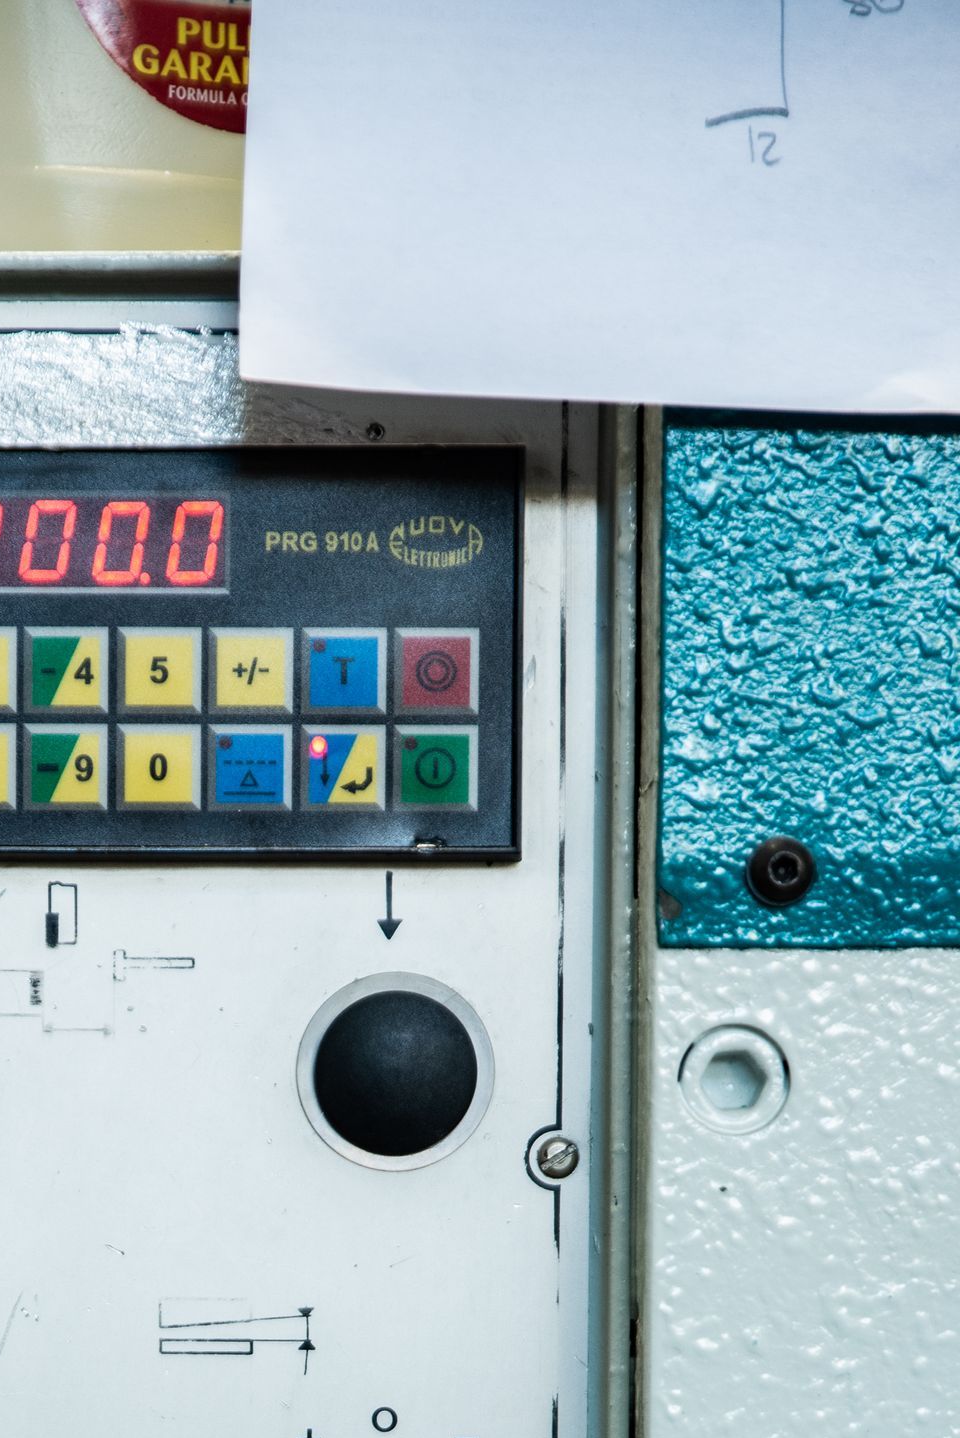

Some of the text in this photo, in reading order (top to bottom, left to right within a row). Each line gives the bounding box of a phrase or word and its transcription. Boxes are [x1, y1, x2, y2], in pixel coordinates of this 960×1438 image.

[177, 17, 251, 51] PUL
[168, 85, 237, 105] FORMULA
[265, 531, 318, 551] PRG
[74, 657, 94, 685] 4
[149, 656, 169, 684] 5
[232, 656, 270, 685] +/-
[332, 657, 355, 685] T
[74, 754, 94, 782] 9
[149, 753, 168, 781] 0
